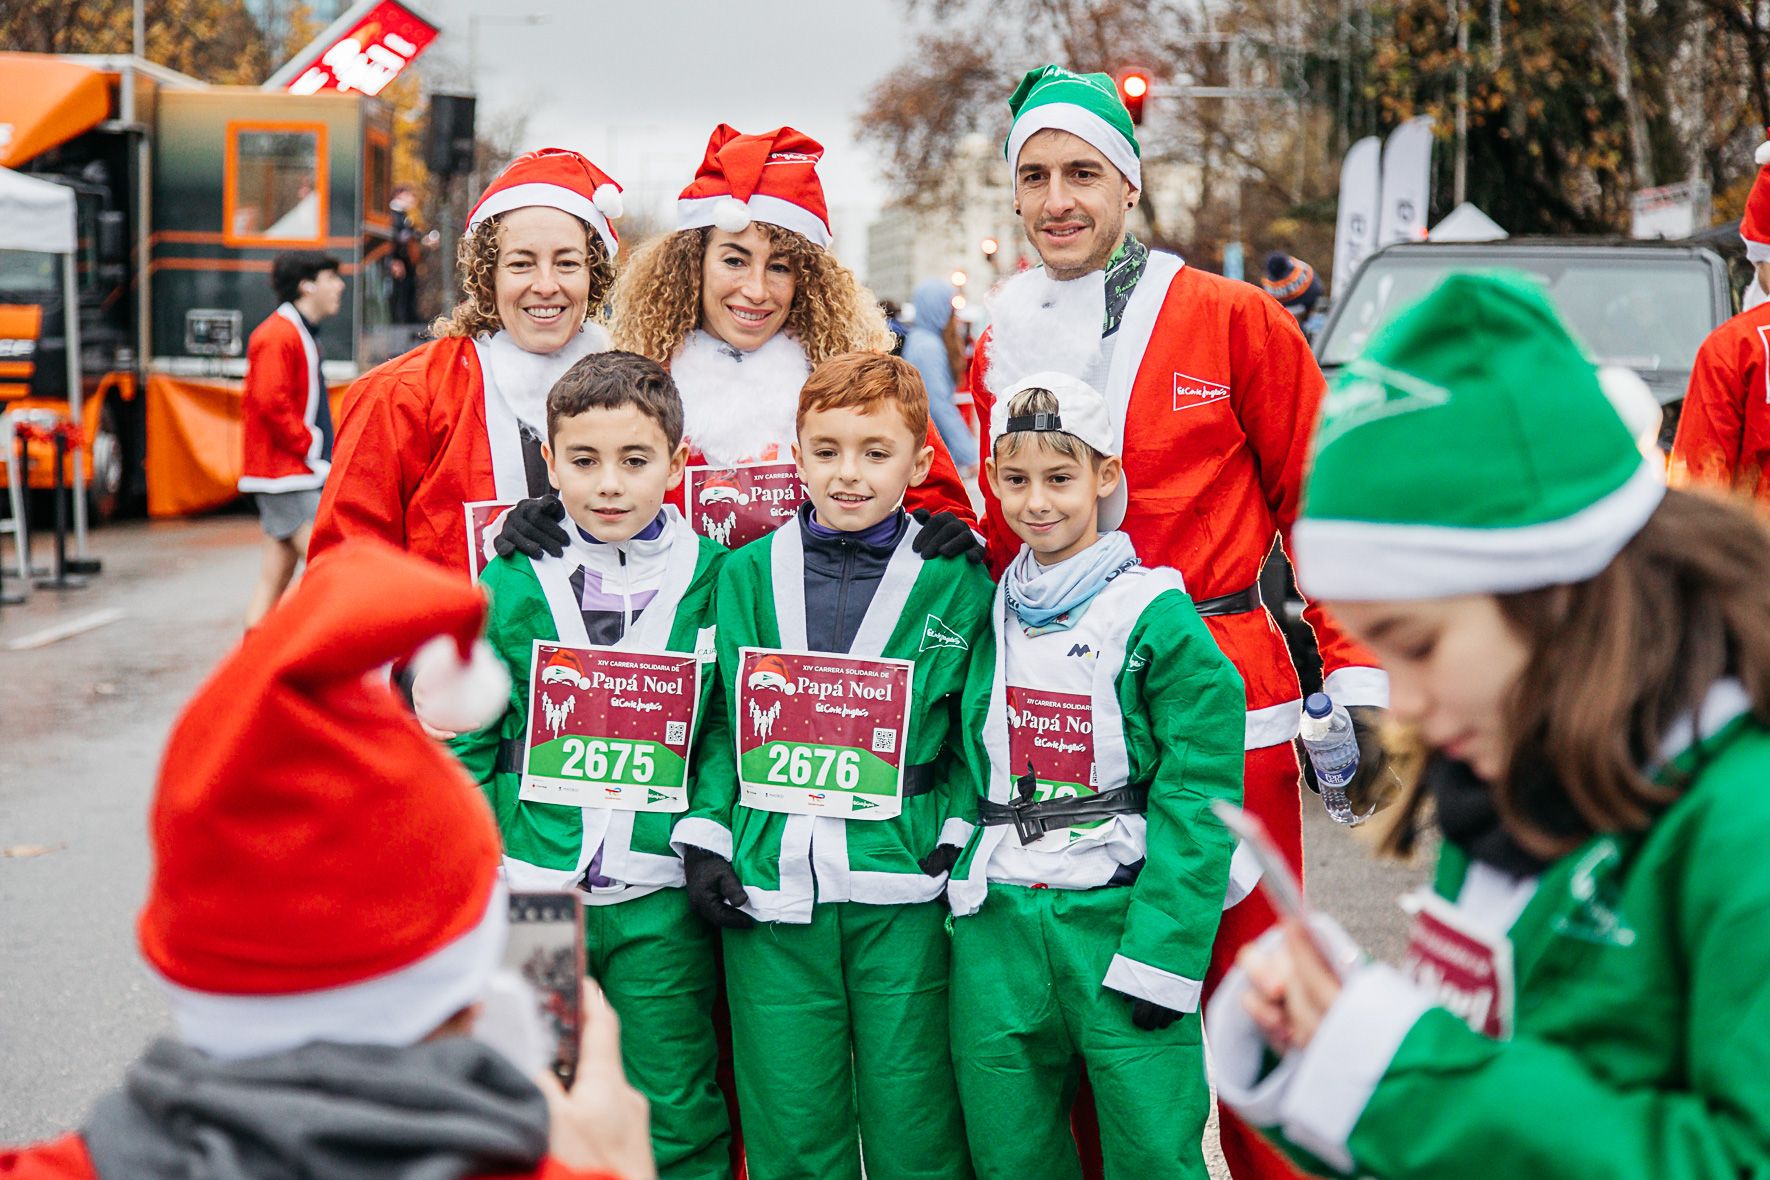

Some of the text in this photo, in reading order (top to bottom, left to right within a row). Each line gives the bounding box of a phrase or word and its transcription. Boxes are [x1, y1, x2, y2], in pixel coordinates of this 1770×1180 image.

[750, 484, 795, 505] Papá
[610, 660, 638, 669] CARRERA
[639, 663, 671, 672] SOLIDARIA
[814, 666, 844, 674] CARRERA
[845, 668, 879, 677] SOLIDARIA
[592, 671, 683, 695] Papá Noel
[796, 677, 892, 701] Papá Noel
[1034, 700, 1061, 708] CARRERA
[1021, 710, 1092, 734] Papá No
[560, 738, 655, 782] 2675
[767, 744, 861, 790] 2676
